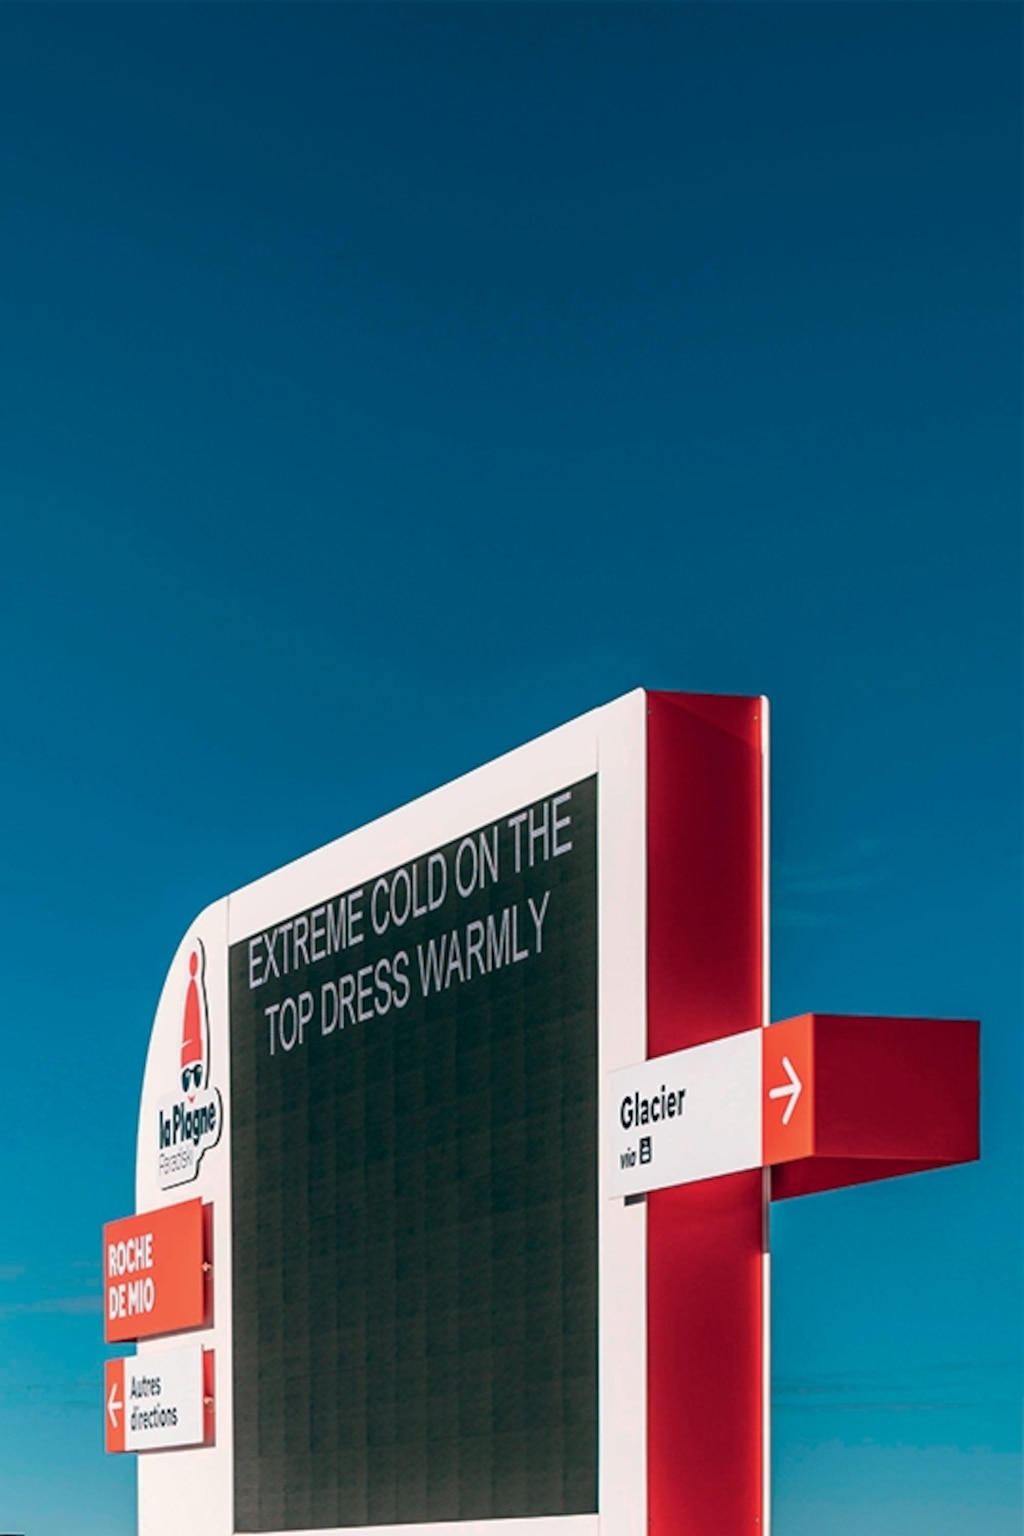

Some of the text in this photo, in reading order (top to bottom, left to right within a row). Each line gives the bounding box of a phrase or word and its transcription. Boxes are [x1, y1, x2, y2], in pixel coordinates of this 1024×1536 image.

[249, 791, 573, 989] EXTREME COLD ON THE
[264, 890, 551, 1055] TOP DRESS WARMLY
[172, 1101, 216, 1146] Plagne
[620, 1083, 686, 1130] Glacier
[620, 1147, 636, 1169] via
[108, 1232, 153, 1278] ROCHE
[108, 1276, 155, 1320] DE MIO
[130, 1375, 162, 1399] Autres
[130, 1402, 178, 1431] directions
